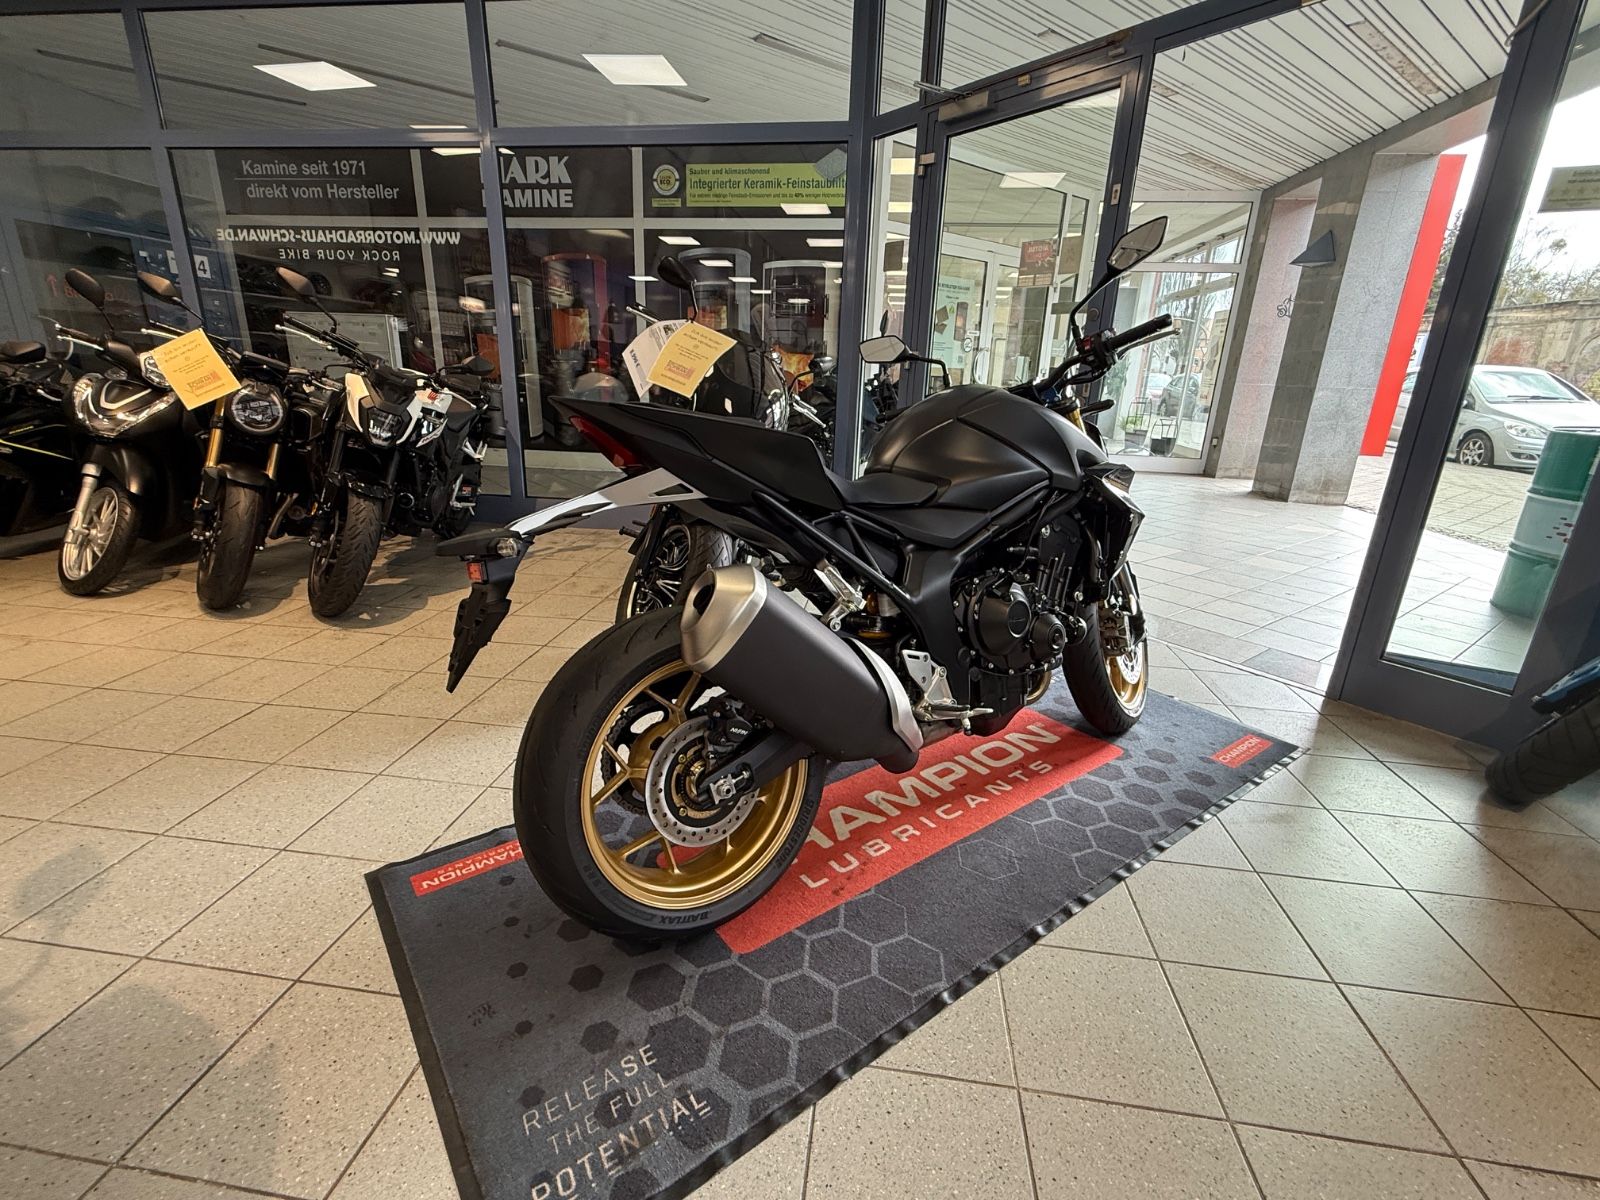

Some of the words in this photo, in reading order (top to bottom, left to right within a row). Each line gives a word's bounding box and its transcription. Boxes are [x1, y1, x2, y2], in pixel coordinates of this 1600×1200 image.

[241, 160, 298, 175] Kamine
[301, 160, 329, 175] seit
[332, 160, 367, 175] 1971
[479, 155, 572, 185] ARK
[689, 167, 710, 175] Sauber
[711, 167, 722, 175] und
[724, 167, 770, 175] klimaschonend
[246, 183, 289, 199] direkt
[291, 186, 323, 199] vom
[326, 183, 400, 200] Hersteller
[689, 178, 741, 191] Integrierter
[482, 188, 574, 208] AMINE
[197, 259, 208, 275] 4
[803, 724, 1062, 849] AMPION
[800, 760, 1053, 889] LUBRICANTS
[421, 847, 523, 890] HAMPION
[659, 910, 710, 925] BATTLAX
[522, 1044, 657, 1136] RELEASE
[547, 1111, 600, 1155] THE
[609, 1072, 672, 1119] FULL
[531, 1089, 708, 1200] POTENTIAL
